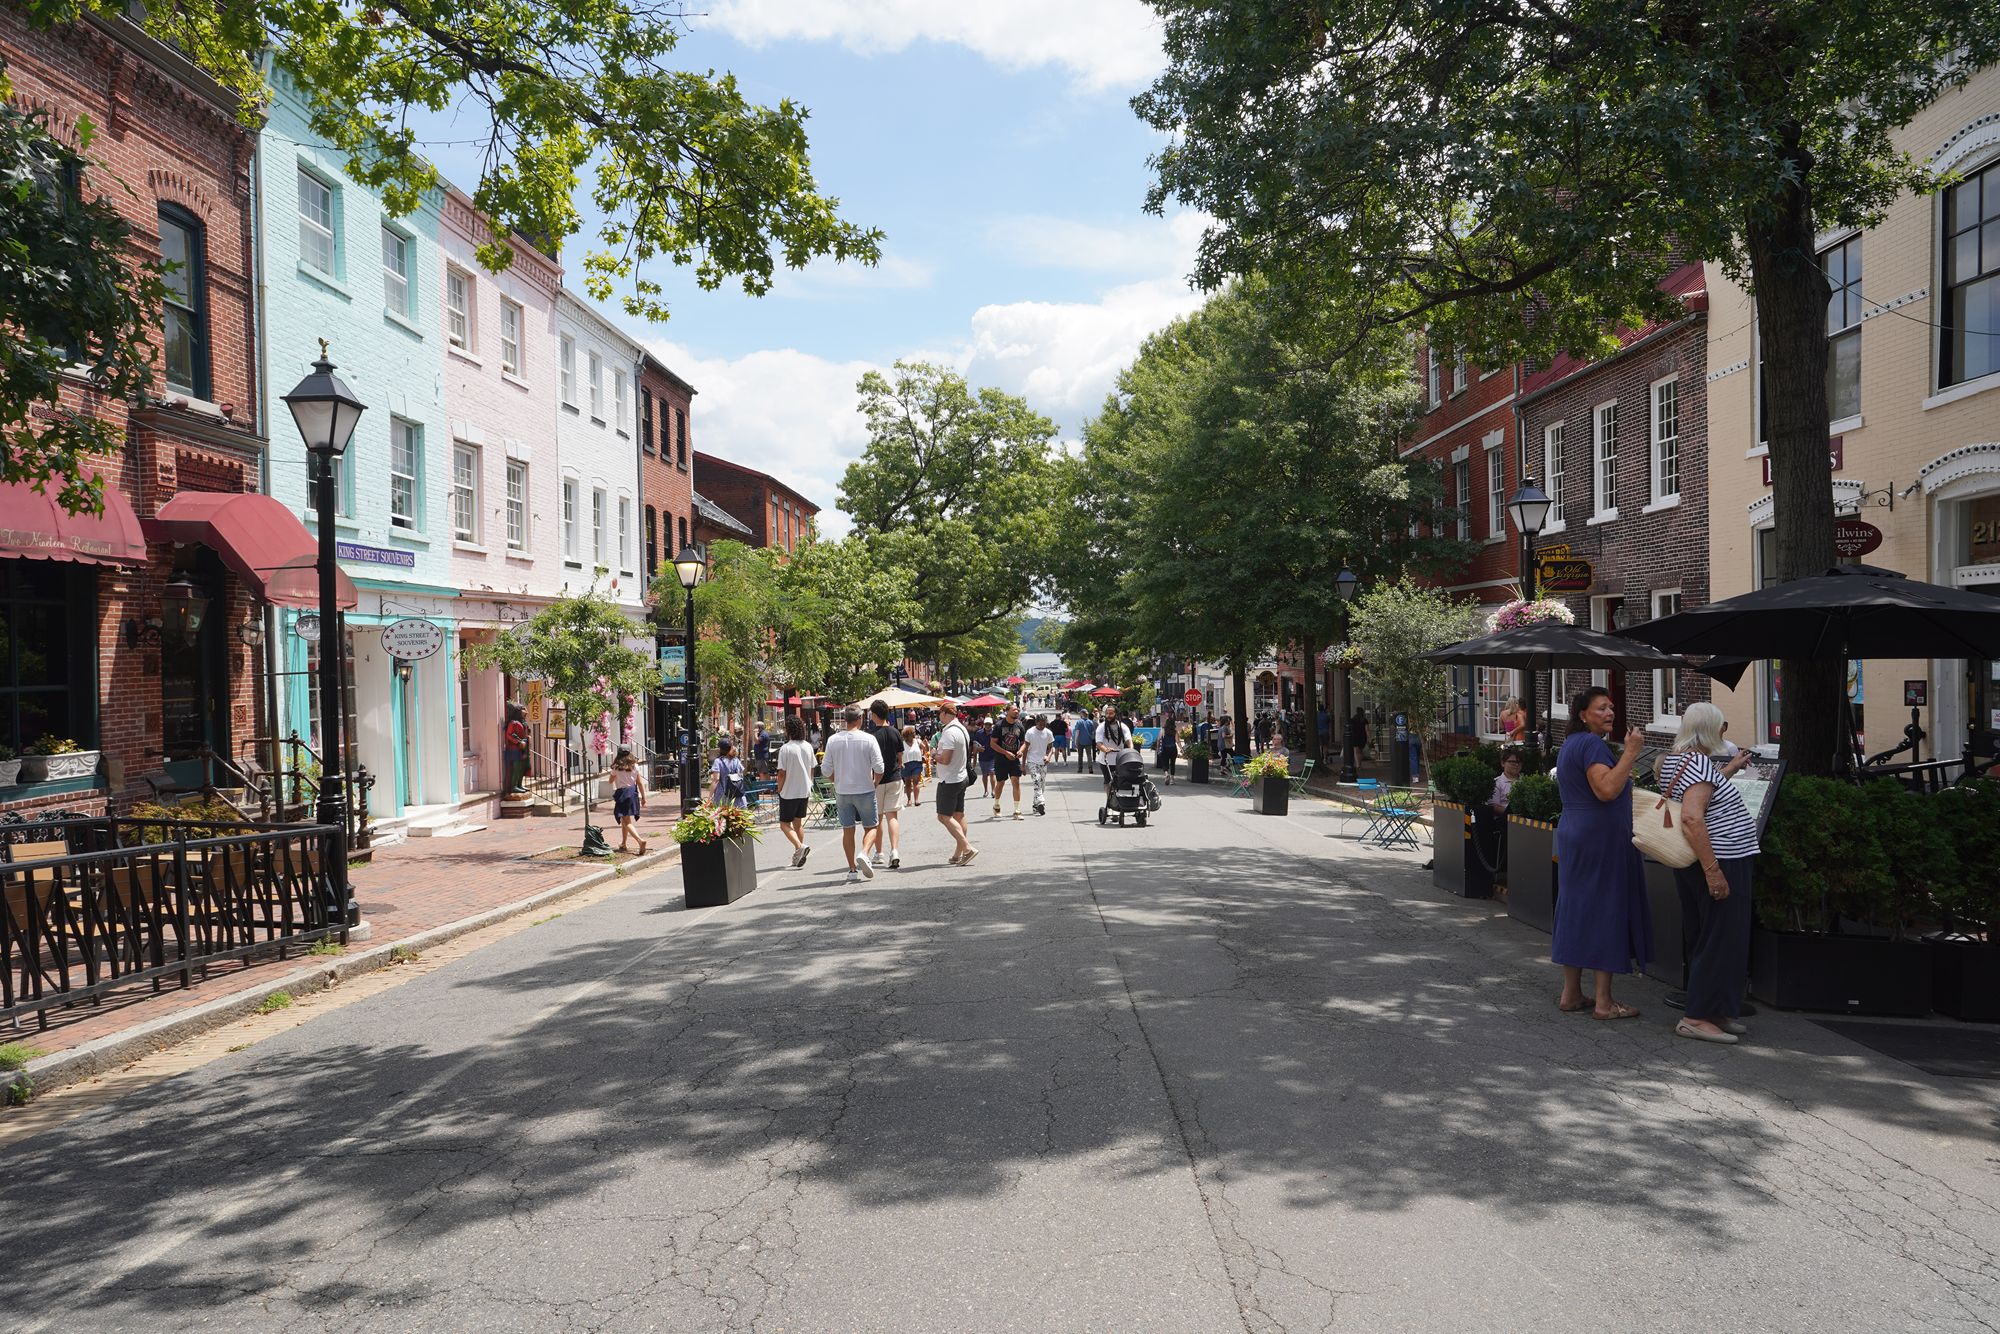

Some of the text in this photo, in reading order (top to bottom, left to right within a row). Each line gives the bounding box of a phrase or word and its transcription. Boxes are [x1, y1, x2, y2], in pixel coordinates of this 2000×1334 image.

[0, 528, 112, 555] Two Nineteen Restaurant
[1836, 528, 1873, 538] ilwins
[1973, 519, 2000, 543] 21
[338, 545, 413, 566] KING STREET SOUVENIRS
[1564, 564, 1586, 573] Old
[532, 680, 540, 719] IGARS
